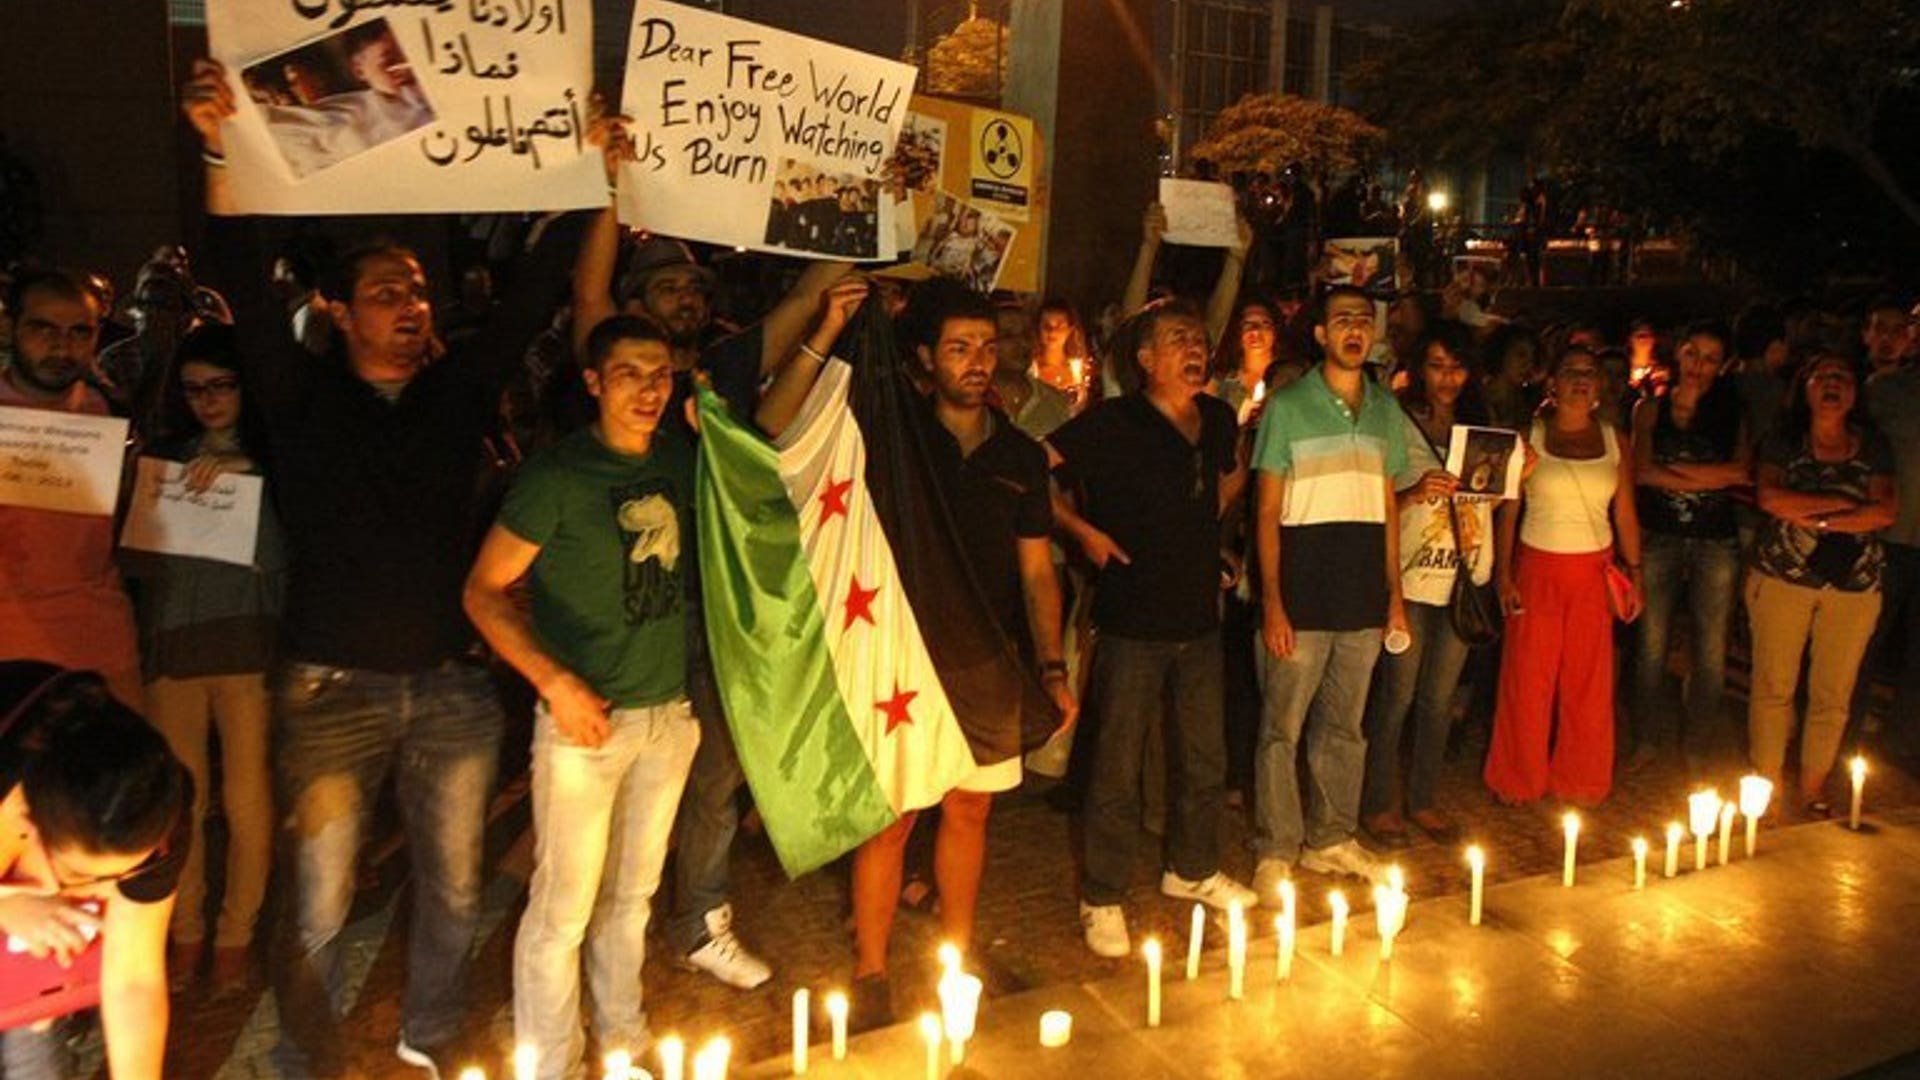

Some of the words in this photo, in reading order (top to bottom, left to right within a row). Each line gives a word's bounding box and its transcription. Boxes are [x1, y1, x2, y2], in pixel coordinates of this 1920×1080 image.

[421, 18, 520, 79] فماذا
[638, 18, 713, 67] Dear
[726, 40, 799, 97] Free
[808, 59, 901, 124] World
[526, 88, 584, 170] أنتم
[632, 130, 666, 172] Us
[682, 137, 767, 183] Burn
[661, 79, 761, 144] Enjoy
[778, 104, 884, 174] Watching
